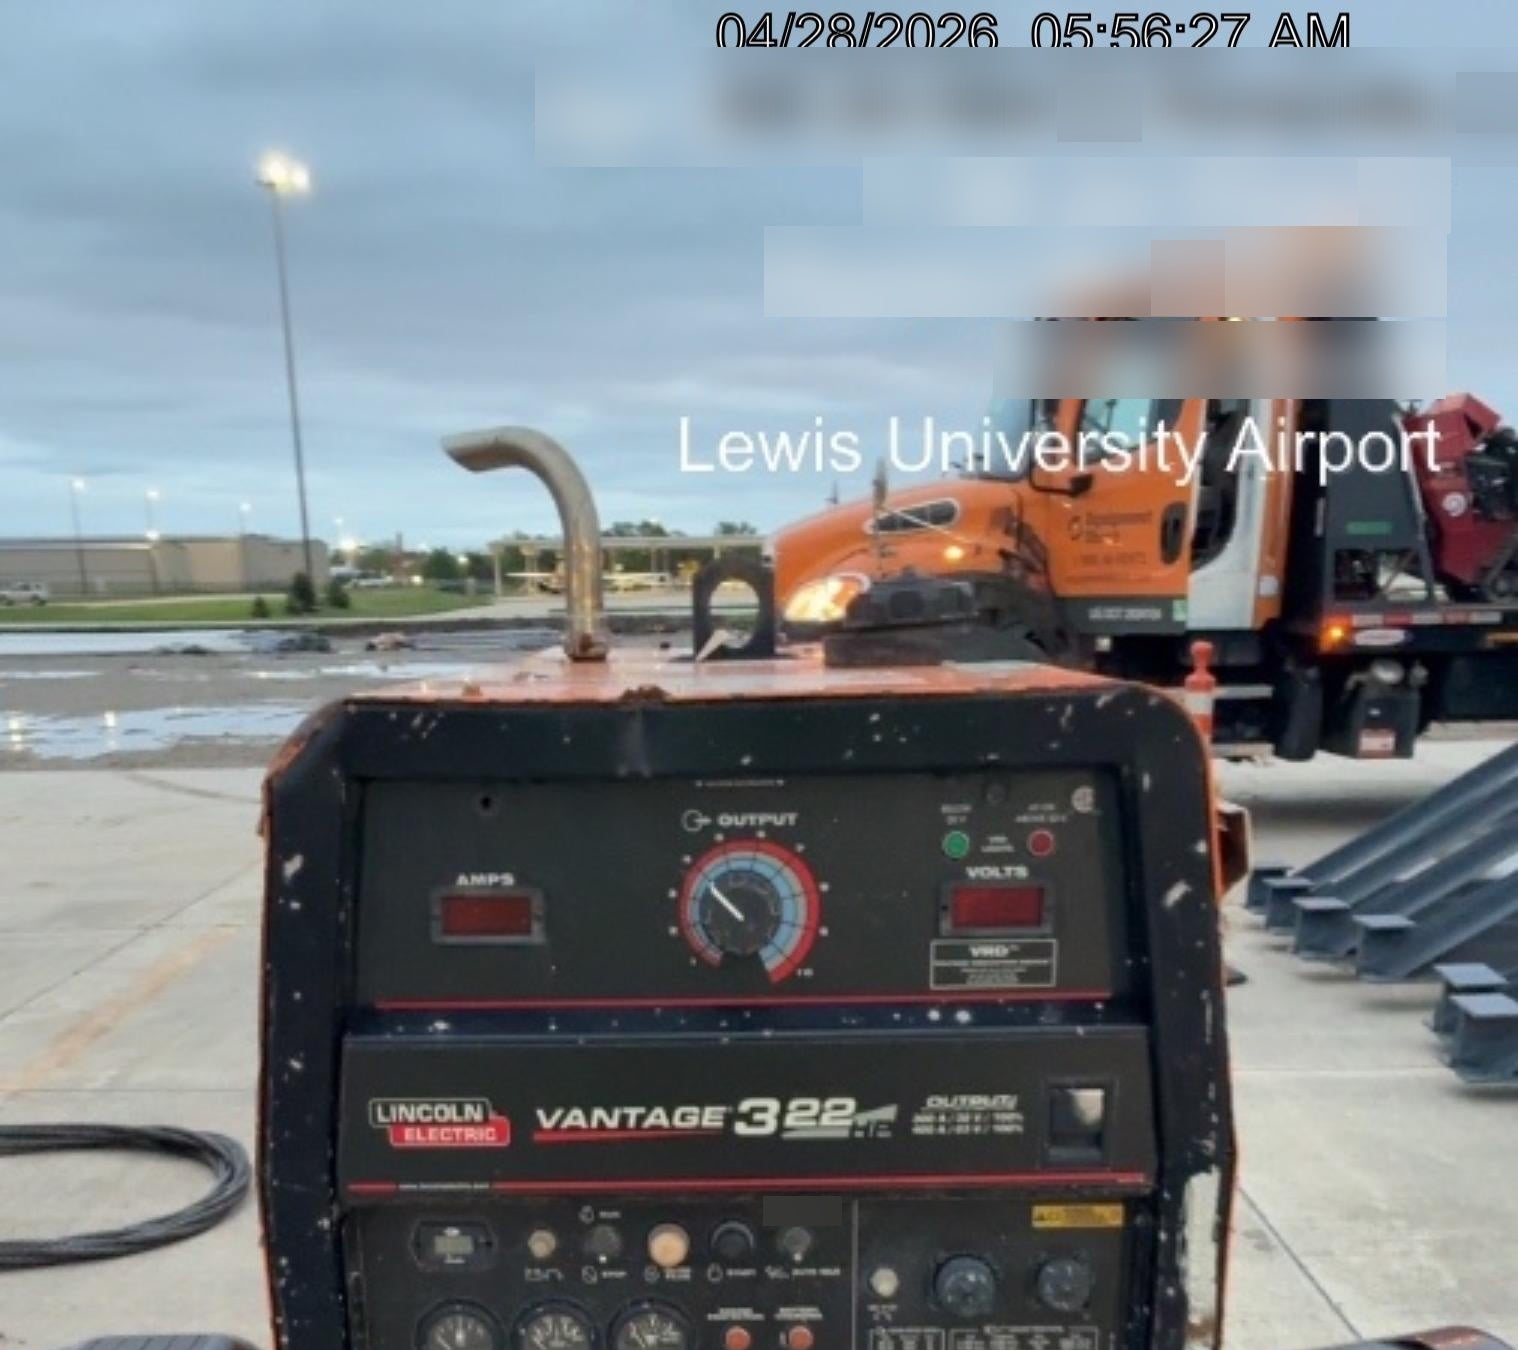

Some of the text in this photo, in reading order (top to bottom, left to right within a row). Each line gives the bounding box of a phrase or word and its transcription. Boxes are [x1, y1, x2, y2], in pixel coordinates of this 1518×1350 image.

[717, 812, 799, 826] OUTPUT
[455, 872, 515, 887] AMPS
[965, 865, 1029, 880] VOLTS
[376, 1103, 484, 1123] LINCOLN
[536, 1096, 857, 1136] VANTAGE 322
[403, 1126, 497, 1142] ELECTRIC
